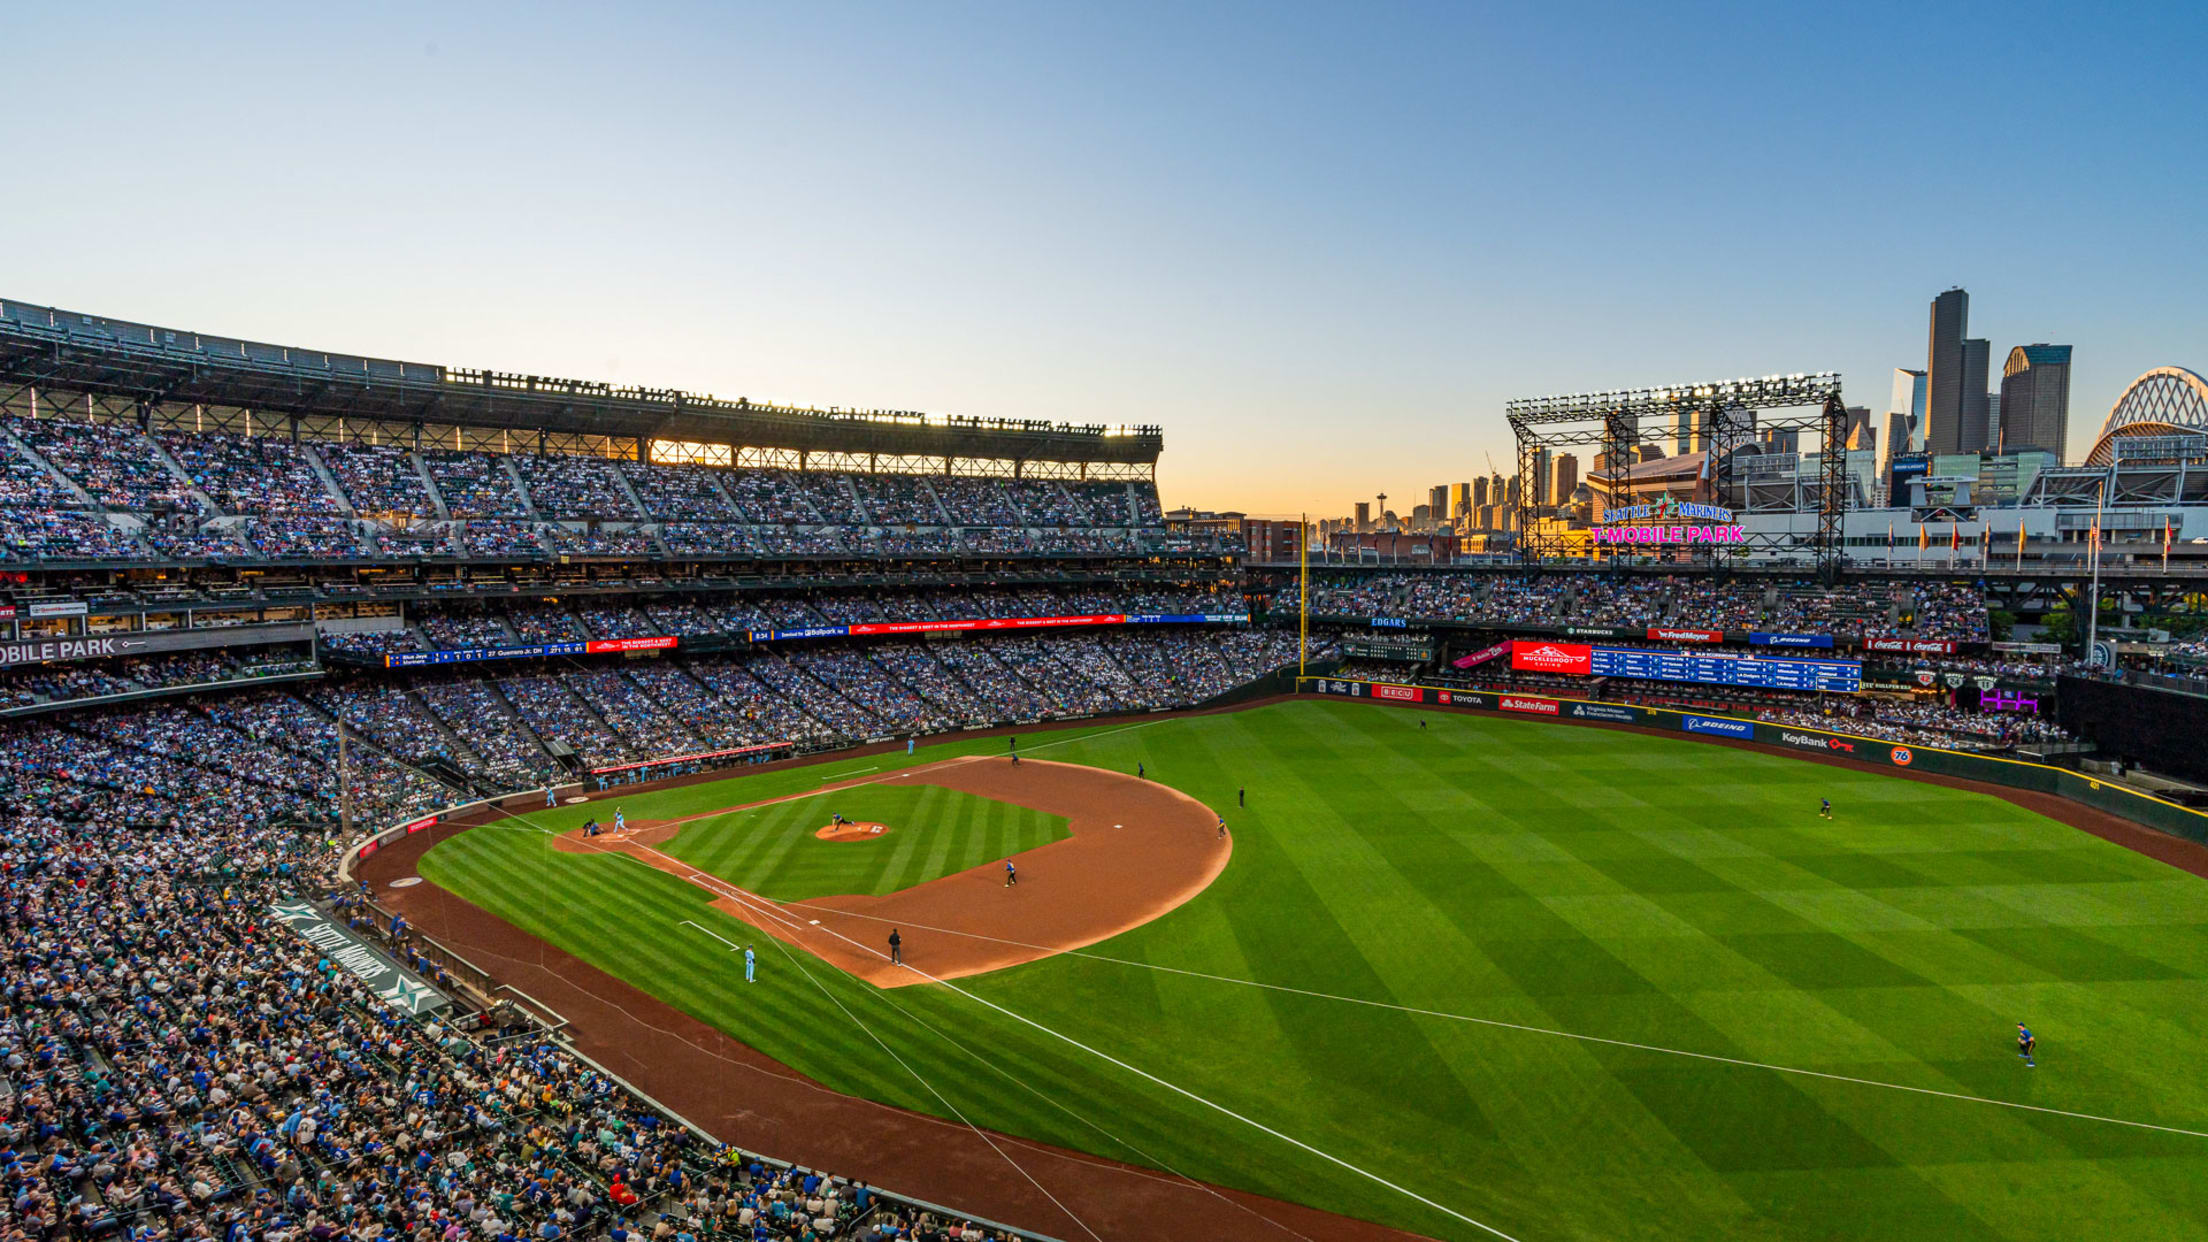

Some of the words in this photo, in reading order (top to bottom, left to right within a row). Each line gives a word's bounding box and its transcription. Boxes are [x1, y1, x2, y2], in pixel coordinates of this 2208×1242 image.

[1602, 504, 1650, 523] SEATTLE
[1678, 501, 1732, 522] MARINERS
[1591, 526, 1683, 543] T-MOBILE
[1687, 525, 1744, 543] PARK
[1371, 618, 1406, 628] EDGARS
[811, 628, 836, 636] Ballpark
[60, 639, 116, 659] PARK
[1523, 656, 1574, 664] MUCKLESHOOT
[1950, 678, 1960, 686] 24
[1982, 681, 1990, 689] 11
[1383, 687, 1412, 698] BECU
[1453, 695, 1482, 704] TOYOTA
[1586, 705, 1606, 713] Virginia
[1607, 707, 1625, 715] Mason
[1701, 721, 1746, 732] BOEING
[1782, 732, 1827, 748] KeyBank
[1895, 751, 1909, 762] 76
